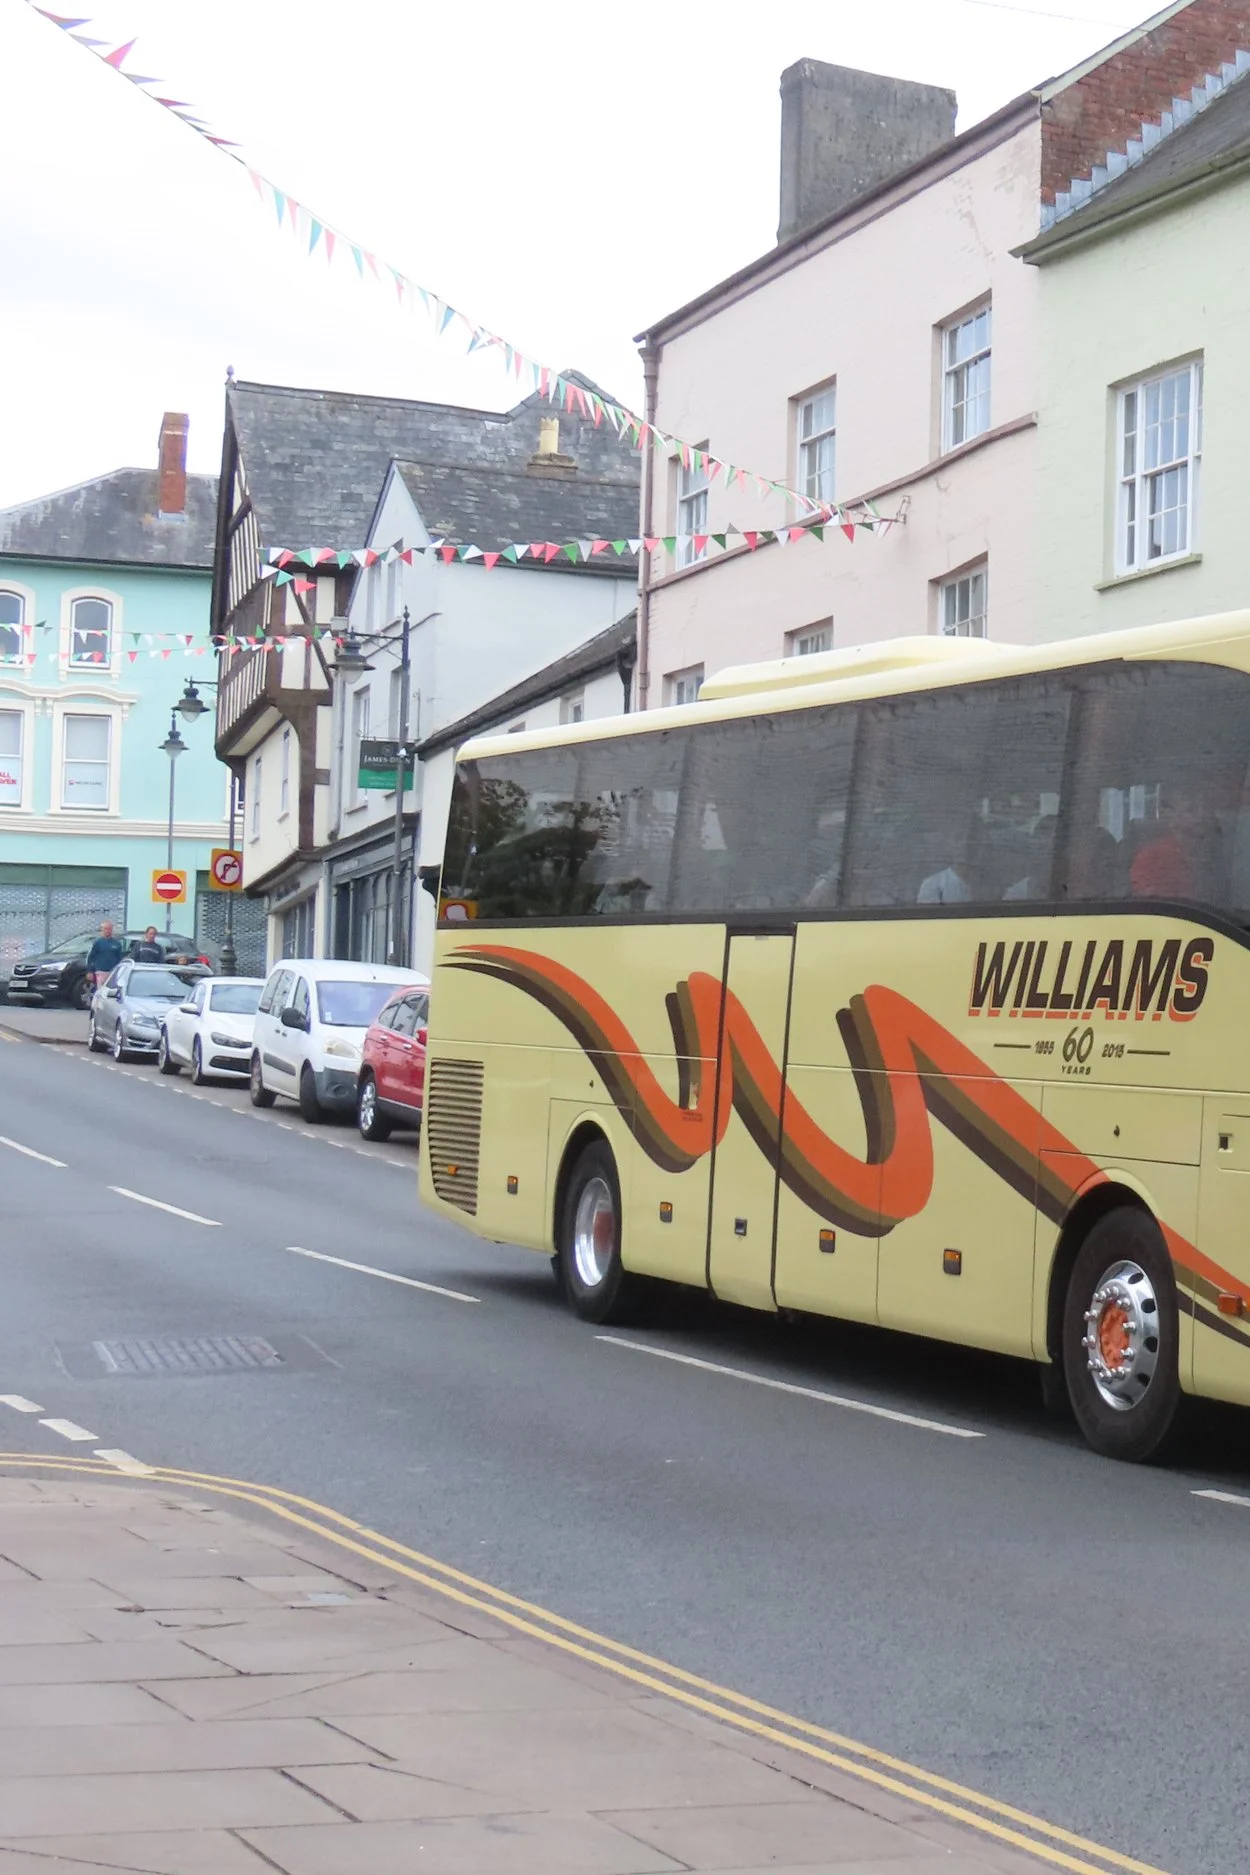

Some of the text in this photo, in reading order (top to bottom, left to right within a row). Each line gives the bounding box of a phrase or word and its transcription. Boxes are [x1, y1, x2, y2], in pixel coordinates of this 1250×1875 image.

[968, 937, 1215, 1022] WILLIAMS
[1062, 1026, 1094, 1064] 60
[1101, 1043, 1125, 1059] 2015
[1061, 1065, 1092, 1076] YEARS
